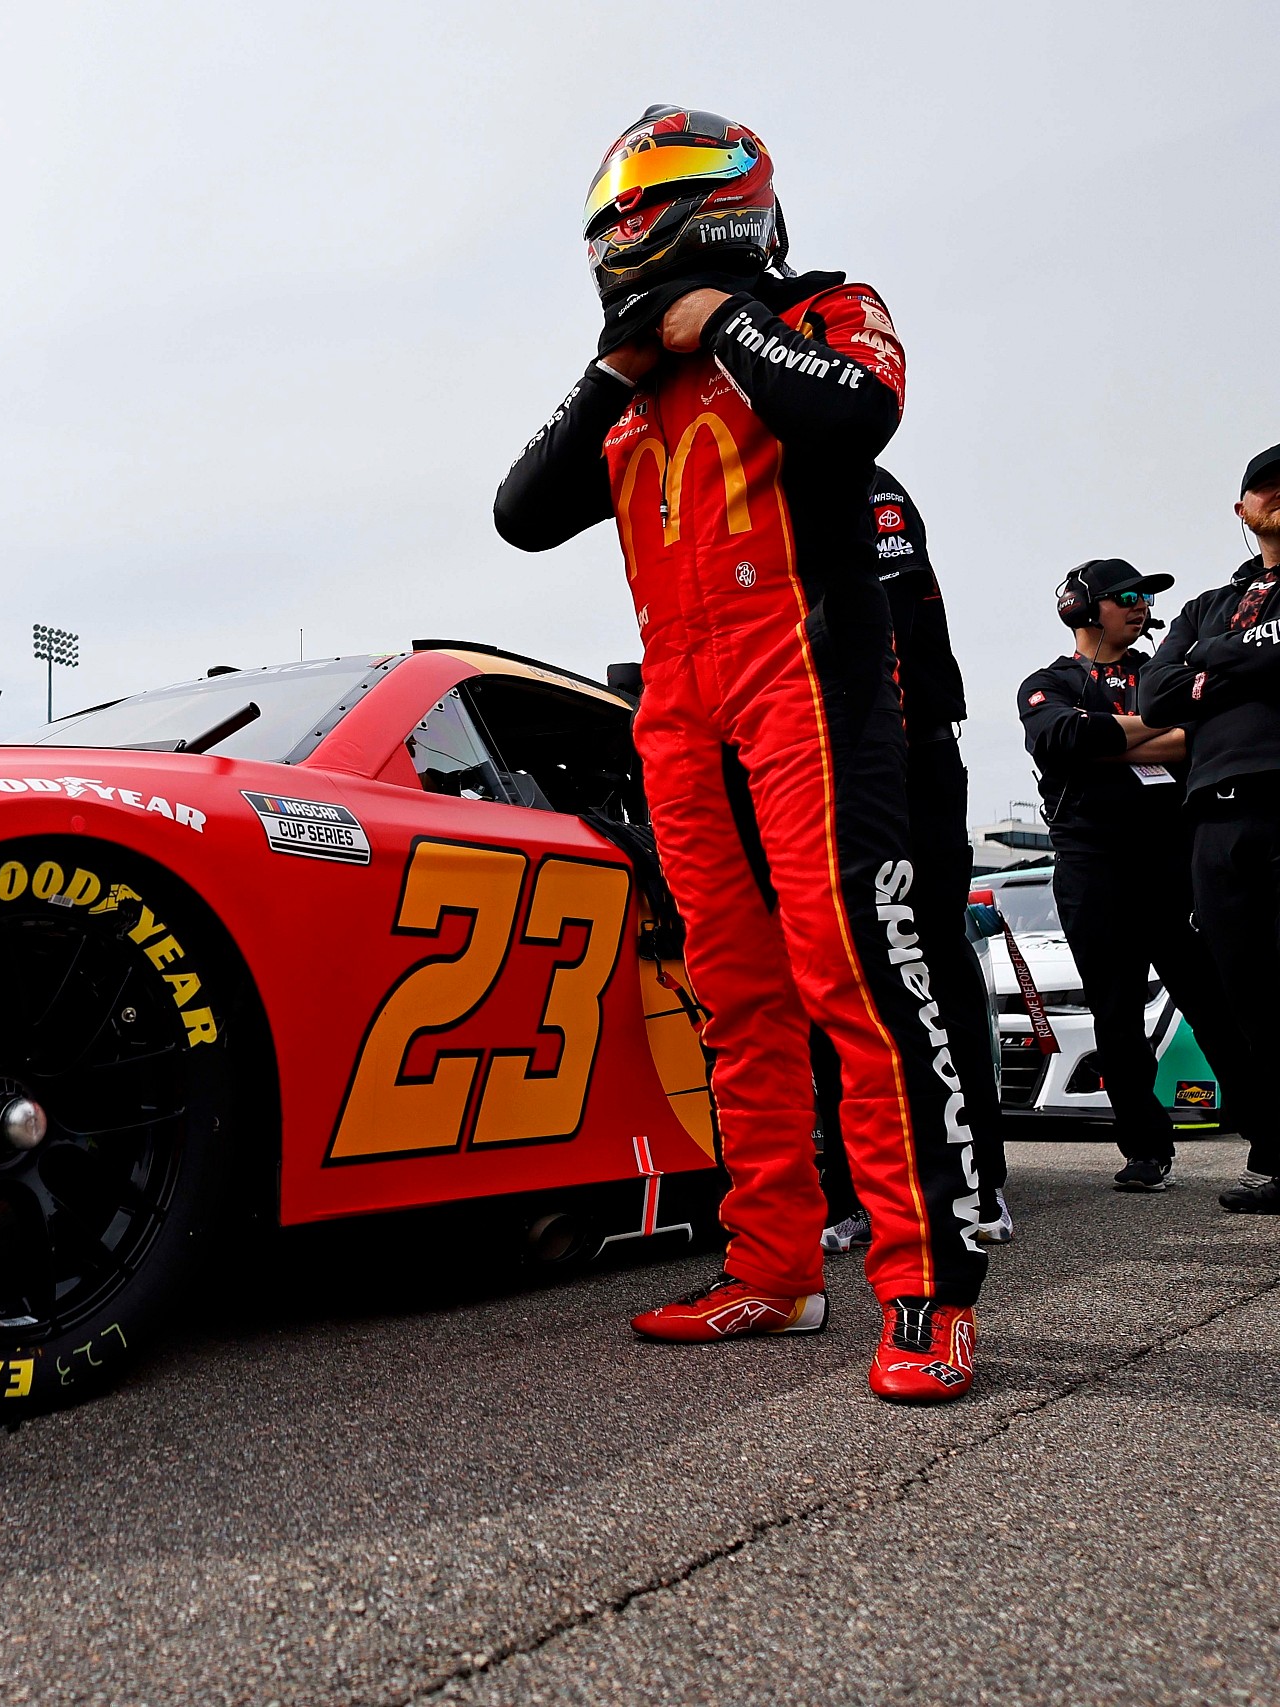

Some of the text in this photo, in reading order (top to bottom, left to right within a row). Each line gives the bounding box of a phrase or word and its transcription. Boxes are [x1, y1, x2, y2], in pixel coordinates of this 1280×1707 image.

[700, 222, 727, 243] i'm
[730, 217, 763, 239] lovin'
[725, 311, 765, 353] i'm
[760, 336, 841, 379] lovin'
[837, 362, 865, 389] it
[873, 492, 904, 503] NASCAR
[1242, 620, 1280, 647] bia
[281, 800, 341, 821] NASCAR
[278, 820, 354, 846] CUP SERIES
[1006, 931, 1053, 1038] REMOVE BEFORE FLIGHT
[322, 834, 633, 1168] 23
[1178, 1090, 1213, 1099] SUNOCO
